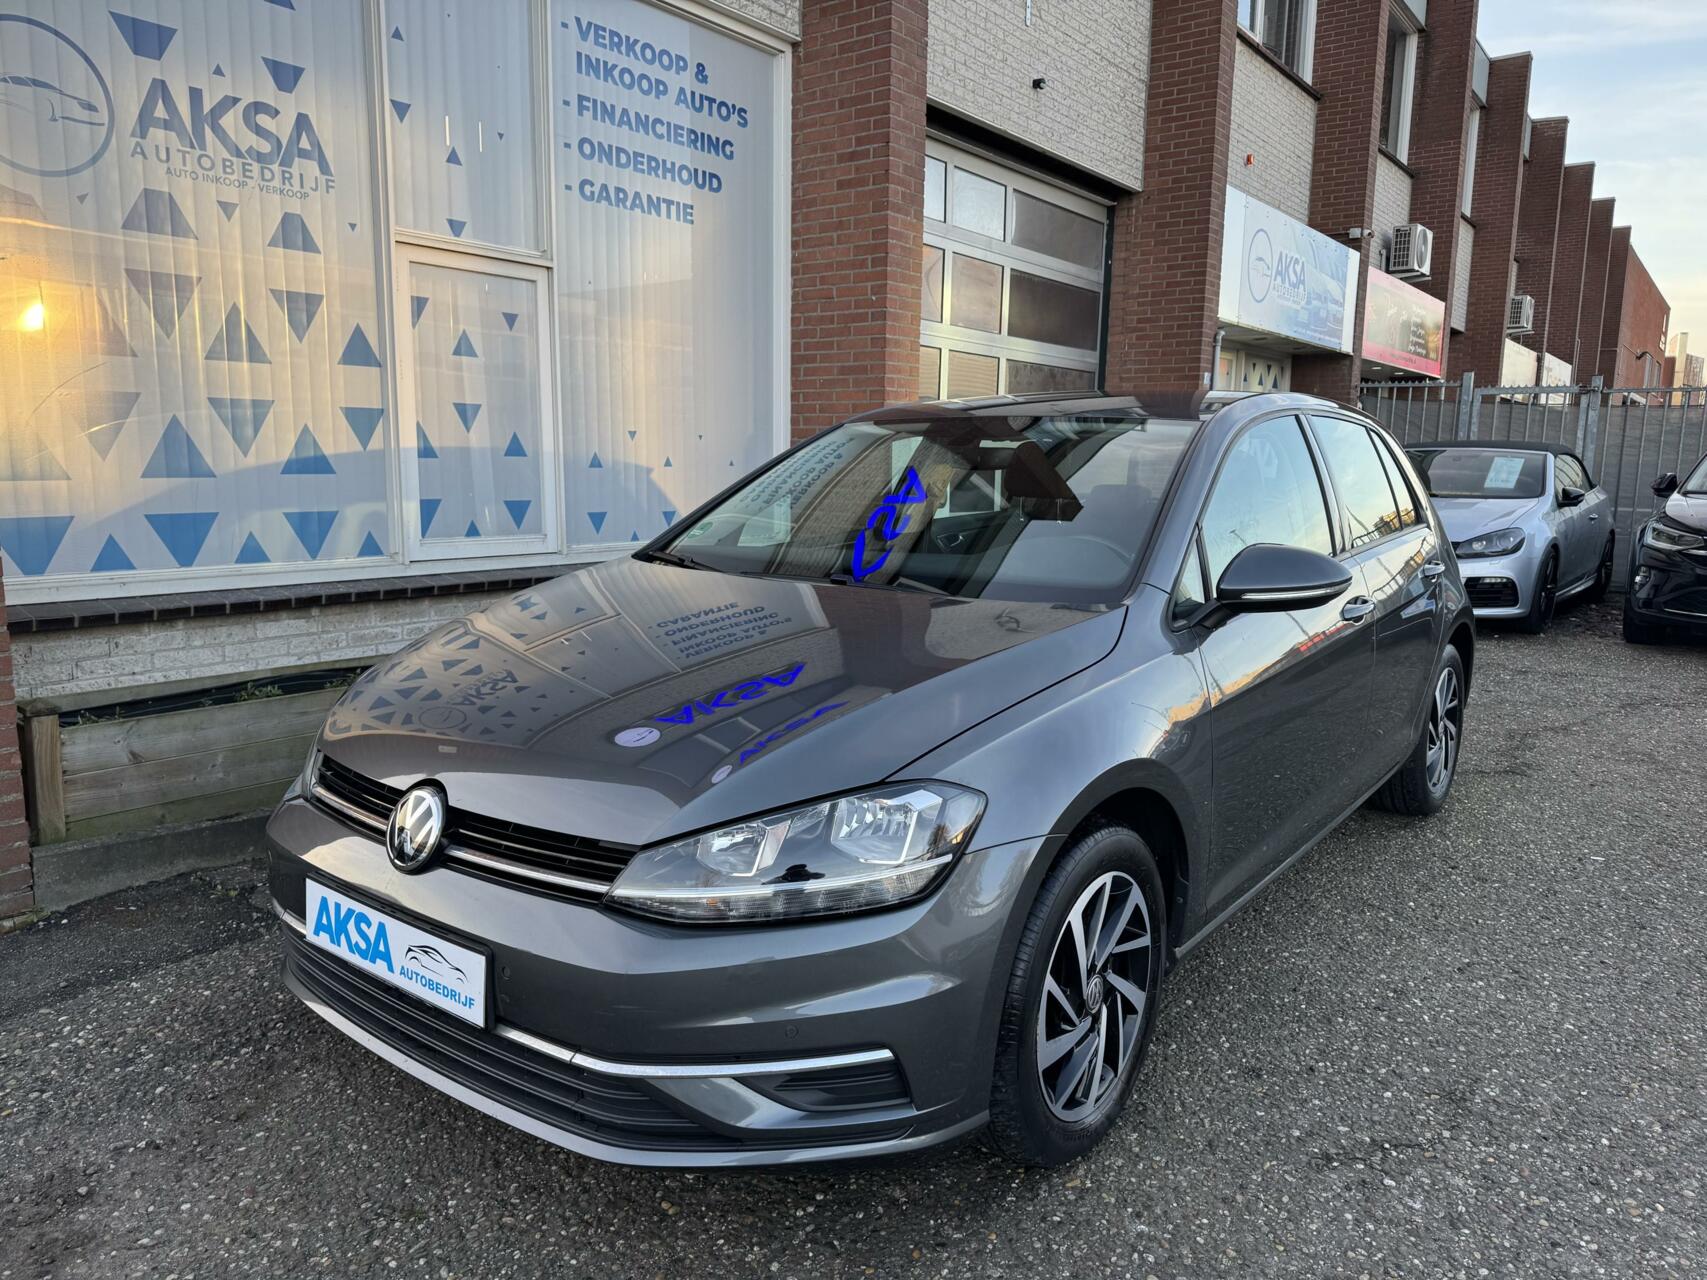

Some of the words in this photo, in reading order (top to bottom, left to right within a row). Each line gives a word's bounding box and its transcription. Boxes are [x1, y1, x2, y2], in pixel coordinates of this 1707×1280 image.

[574, 16, 689, 76] VERKOOP
[694, 62, 709, 85] &
[576, 51, 669, 100] INKOOP
[674, 86, 749, 129] AUTO'S
[130, 77, 335, 177] AKSA
[576, 93, 734, 161] FINANCIERING
[130, 140, 336, 195] AUTOBEDRIJF
[165, 166, 199, 181] AUTO
[202, 174, 248, 190] INKOOP
[257, 183, 310, 201] VERKOOP
[577, 137, 722, 194] ONDERHOUD
[578, 178, 695, 225] GARANTIE
[1273, 250, 1306, 290] AKSA
[312, 895, 395, 975] AKSA
[399, 964, 475, 1010] AUTOBEDRIJF
